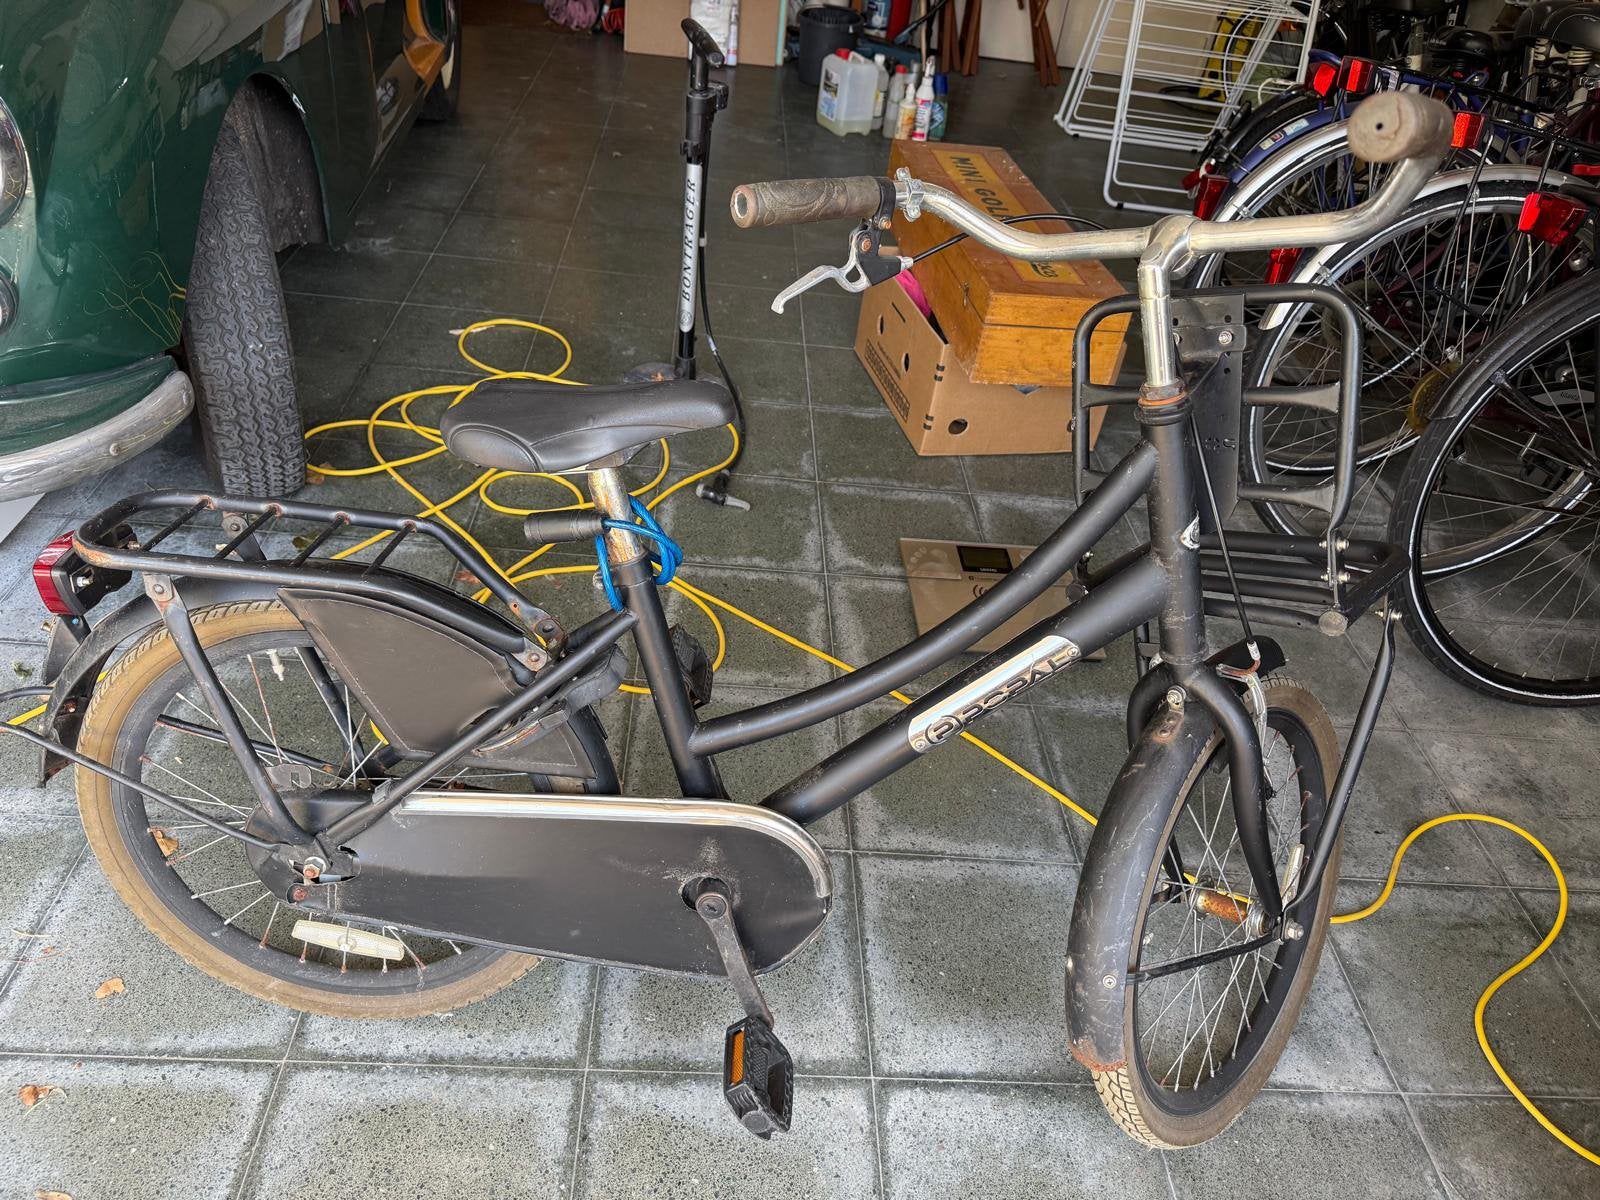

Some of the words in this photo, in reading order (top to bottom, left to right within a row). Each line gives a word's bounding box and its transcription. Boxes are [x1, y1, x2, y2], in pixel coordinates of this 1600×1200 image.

[949, 155, 987, 184] MINI
[681, 179, 697, 302] BONTRAGER
[962, 657, 1072, 723] POPAL
